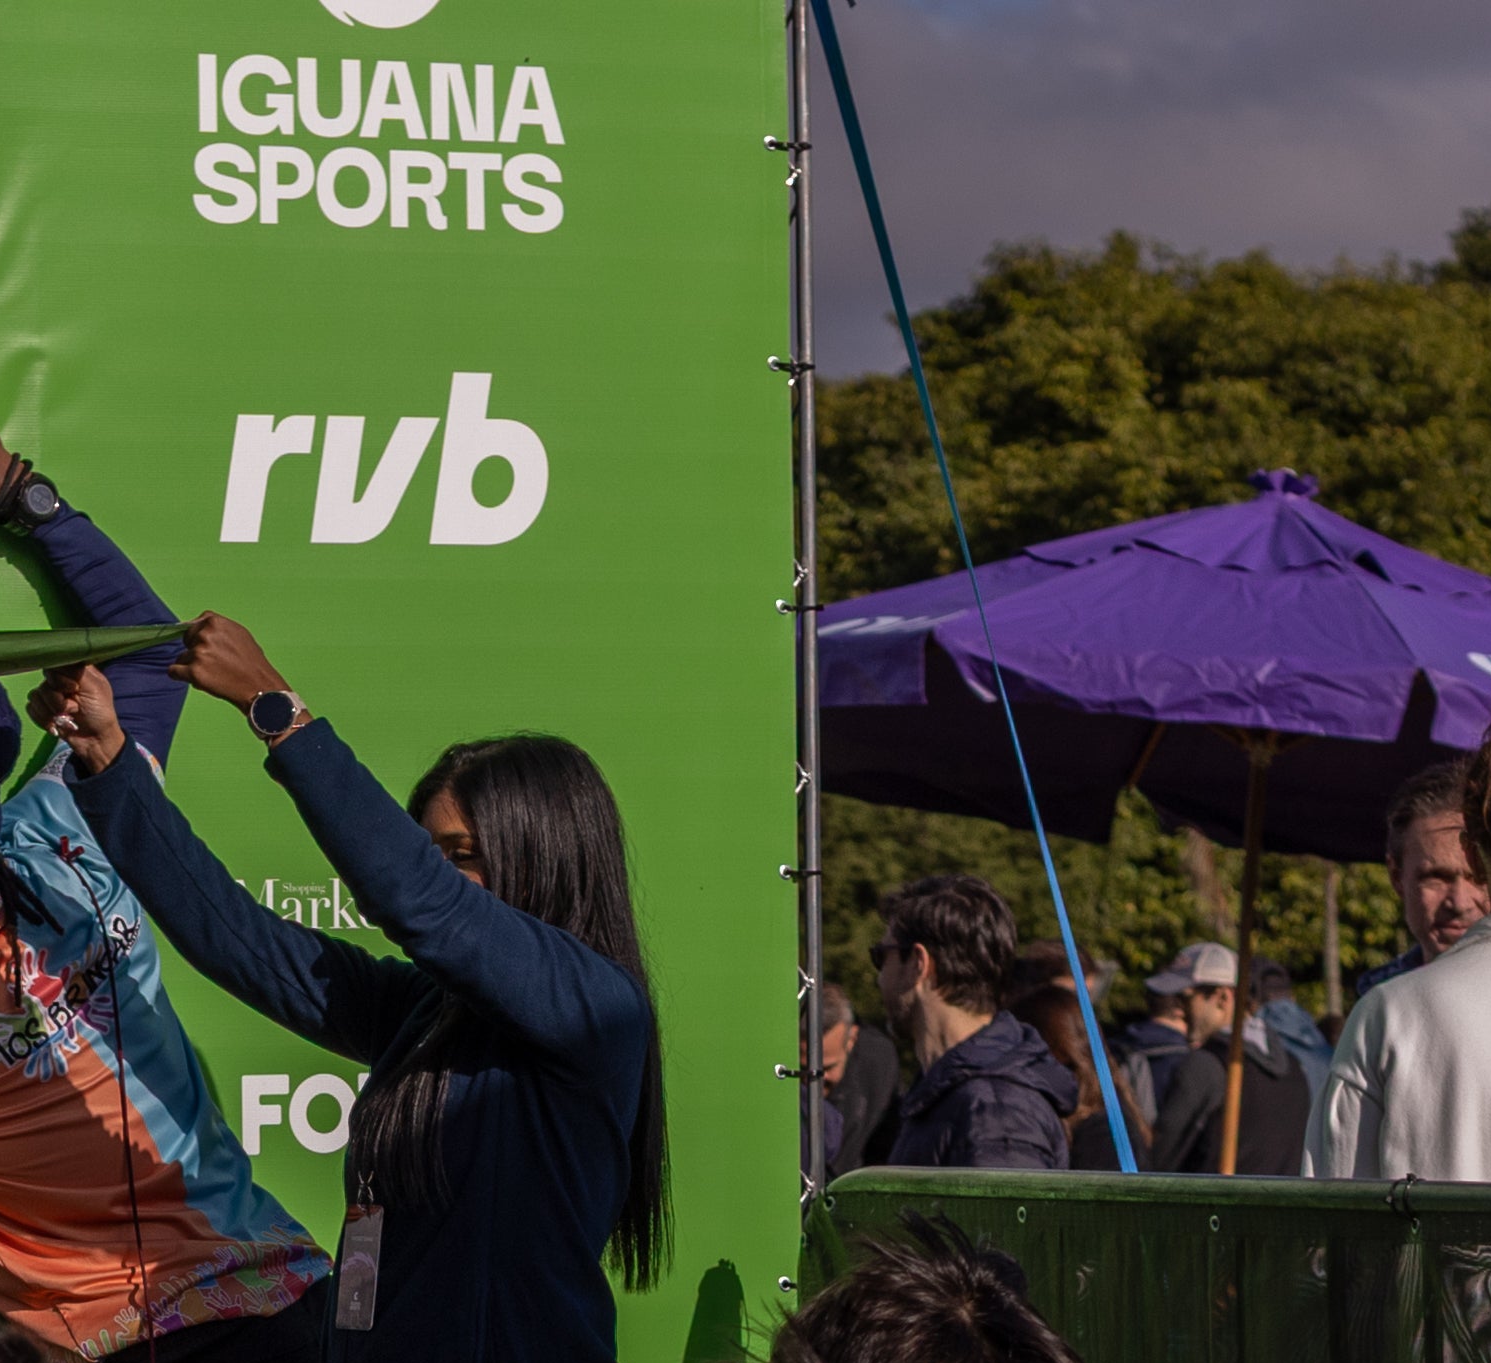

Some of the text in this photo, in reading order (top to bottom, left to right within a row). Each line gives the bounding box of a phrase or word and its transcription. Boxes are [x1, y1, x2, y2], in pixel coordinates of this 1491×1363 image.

[197, 53, 564, 144] IGUANA
[192, 143, 564, 234] SPORTS
[219, 372, 549, 545] rvb
[282, 882, 326, 894] Shopping
[241, 1073, 370, 1156] FO
